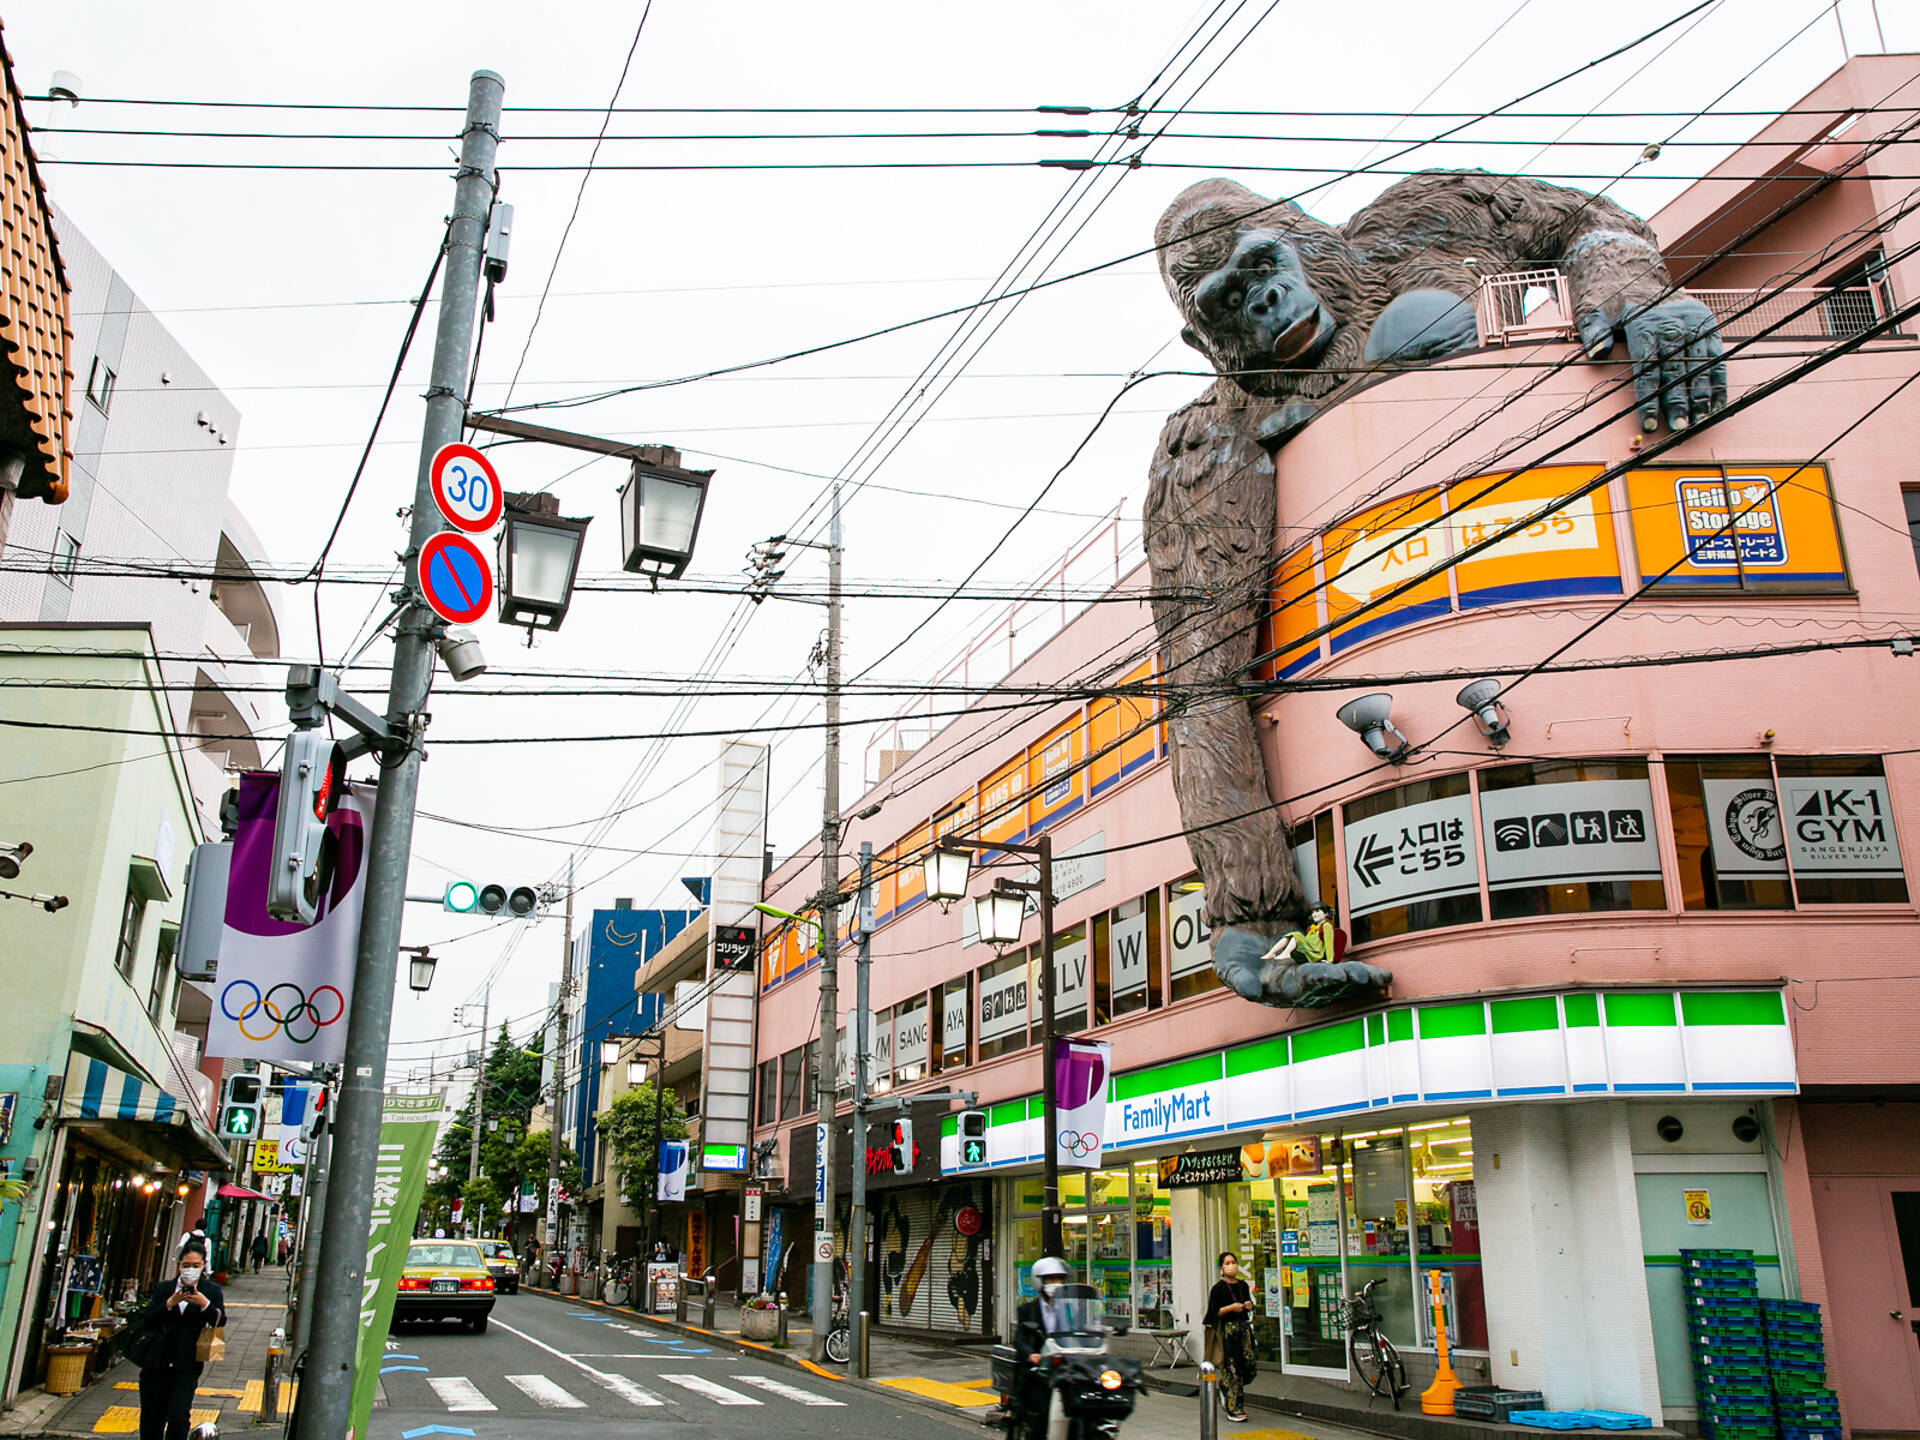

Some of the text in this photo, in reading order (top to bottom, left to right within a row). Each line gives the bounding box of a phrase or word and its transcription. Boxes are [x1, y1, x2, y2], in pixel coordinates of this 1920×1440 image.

[448, 465, 488, 512] 30
[1684, 487, 1742, 508] Hello
[1688, 510, 1773, 531] Storage
[1381, 535, 1430, 573] 入口
[1824, 789, 1882, 817] K-1
[1398, 817, 1464, 850] 入口は
[1797, 819, 1886, 842] GYM
[1400, 843, 1466, 875] こちら
[1801, 845, 1889, 853] SANGENJAYA
[1117, 930, 1142, 970] W
[946, 1007, 965, 1033] AYA
[899, 1023, 928, 1050] SANG
[1123, 1089, 1211, 1133] FamilyMart
